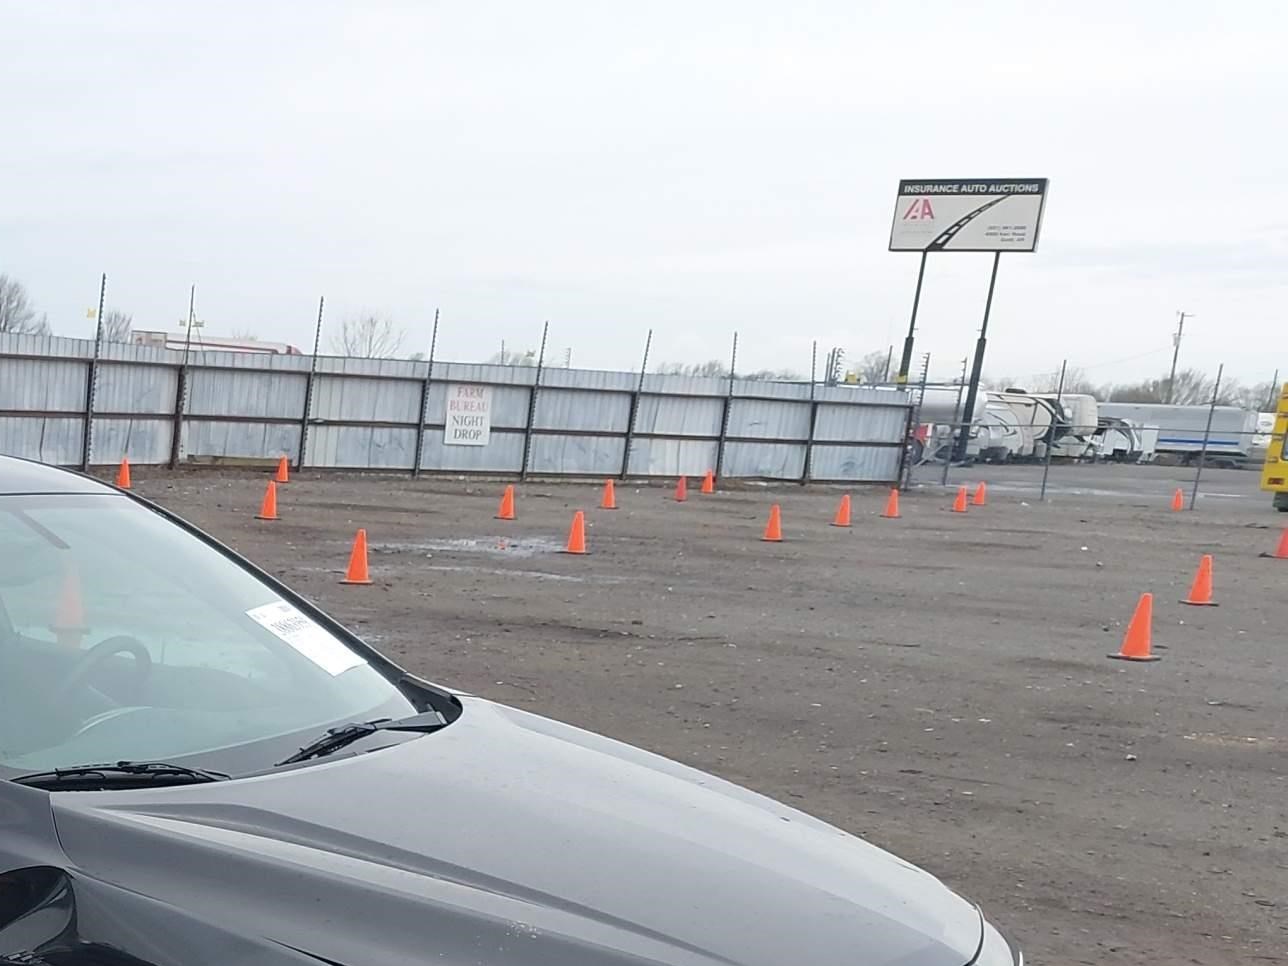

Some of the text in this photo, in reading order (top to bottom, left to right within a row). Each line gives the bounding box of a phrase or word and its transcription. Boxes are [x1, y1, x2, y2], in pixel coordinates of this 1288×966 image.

[904, 183, 1039, 193] INSURANCE AUTO AUCTIONS
[452, 415, 484, 427] NIGHT
[454, 428, 482, 440] DROP
